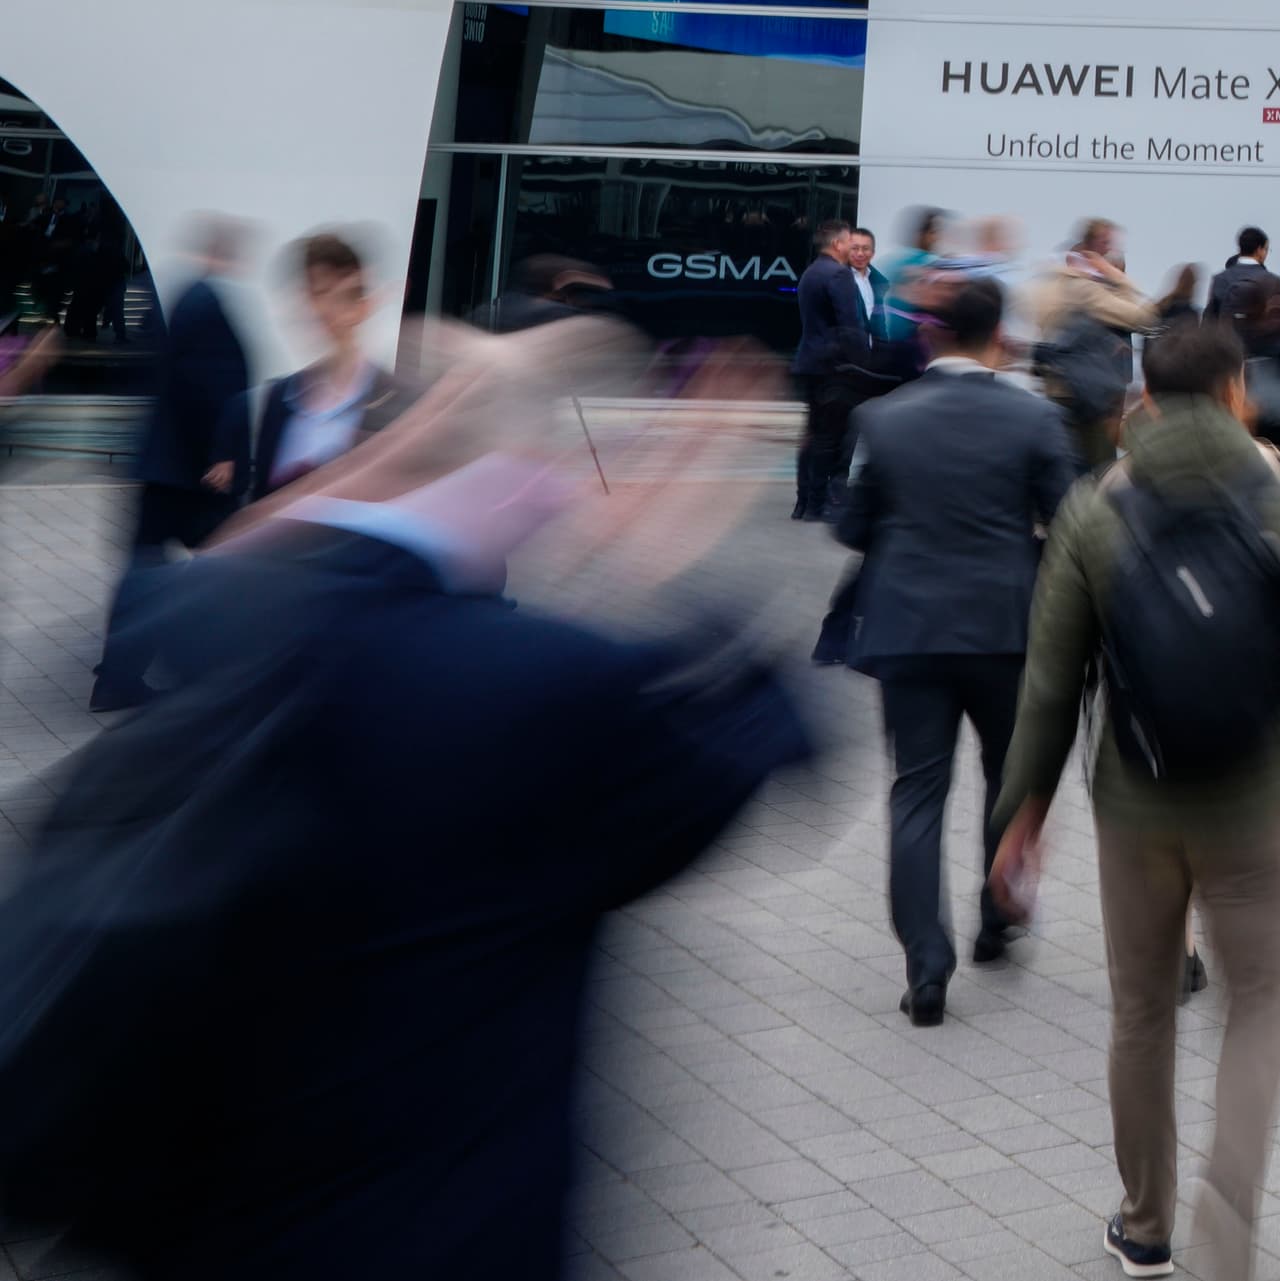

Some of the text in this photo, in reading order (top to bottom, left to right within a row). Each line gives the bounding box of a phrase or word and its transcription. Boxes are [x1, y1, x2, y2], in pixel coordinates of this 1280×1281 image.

[941, 61, 1134, 98] HUAWEI
[1153, 66, 1250, 100] Mate
[986, 133, 1264, 162] Unfold the Moment
[647, 253, 798, 280] GSMA
